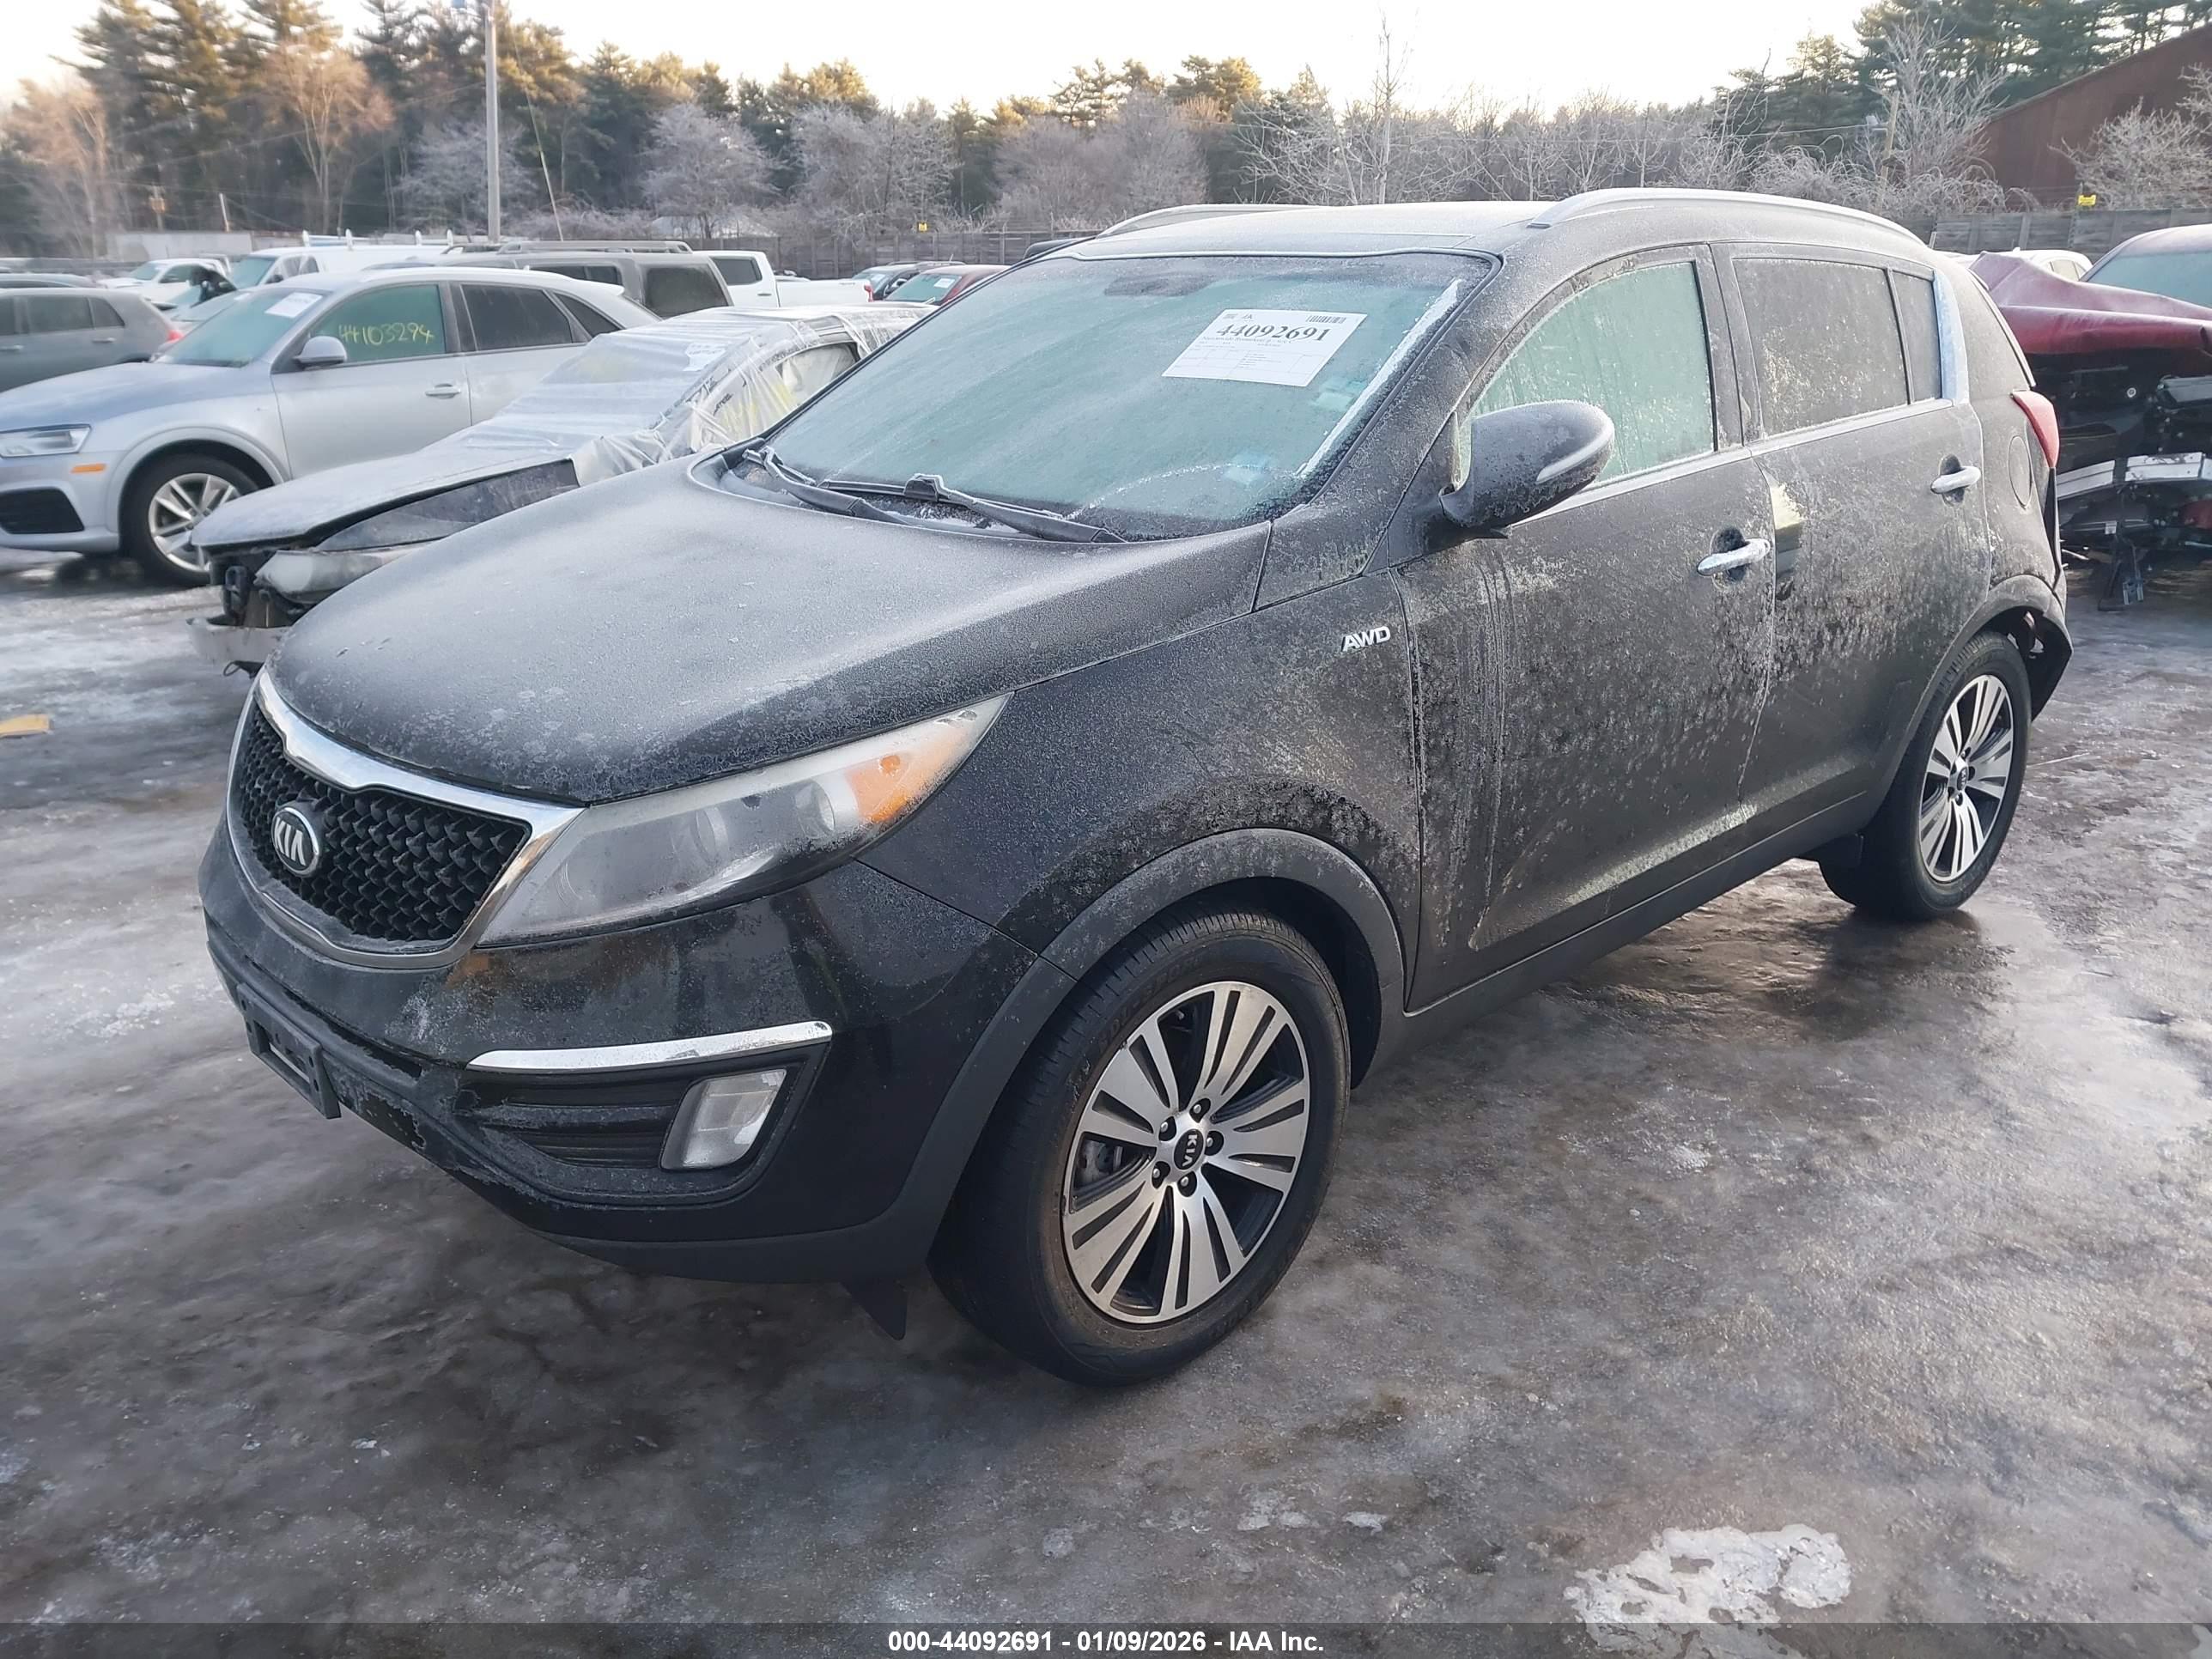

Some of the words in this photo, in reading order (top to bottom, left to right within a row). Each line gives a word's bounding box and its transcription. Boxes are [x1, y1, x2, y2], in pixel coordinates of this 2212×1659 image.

[338, 322, 434, 344] 44103294
[1216, 323, 1331, 342] 44092691
[1341, 626, 1390, 652] AWD
[274, 817, 307, 866] KIA
[1182, 1134, 1198, 1167] KIA
